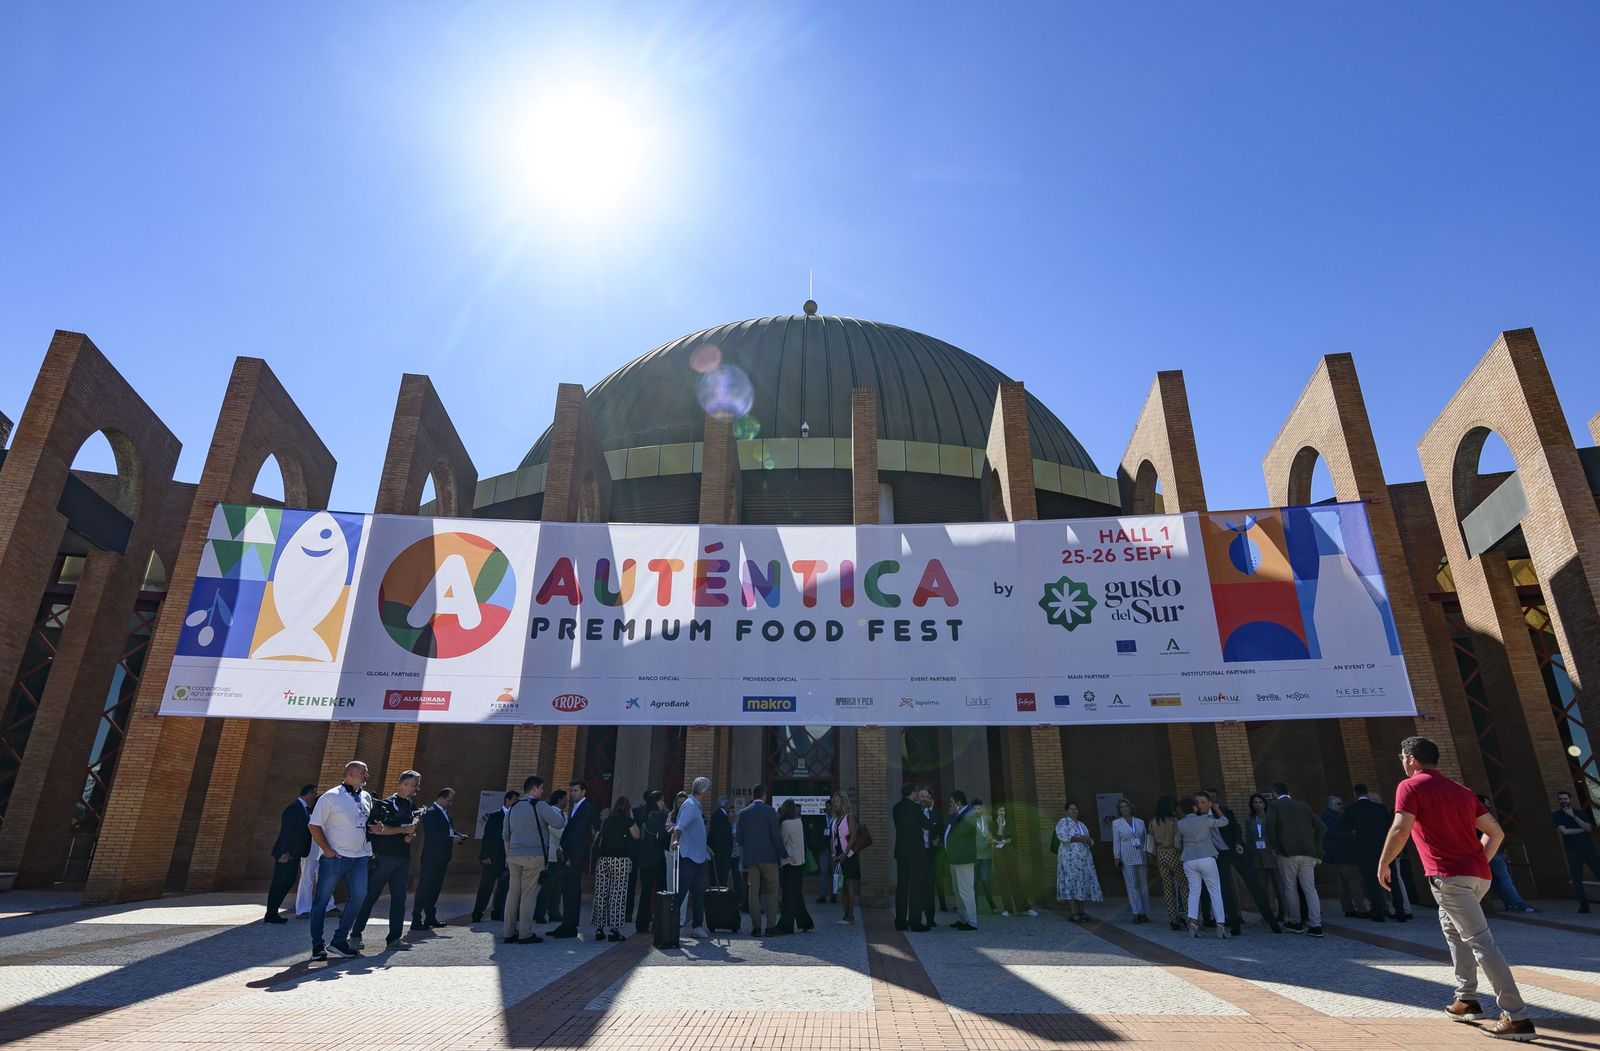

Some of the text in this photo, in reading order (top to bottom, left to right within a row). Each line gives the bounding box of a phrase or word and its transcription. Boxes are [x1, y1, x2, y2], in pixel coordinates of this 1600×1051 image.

[1099, 526, 1169, 544] HALL 1
[1061, 545, 1174, 564] 25-26 SEPT
[535, 541, 960, 608] AUTÉNTICA
[993, 581, 1014, 597] by
[1104, 574, 1182, 608] gusto
[1111, 599, 1185, 624] del Sur
[530, 617, 963, 642] PREMIUM FOOD FEST
[287, 695, 356, 707] HEINEKEN
[553, 695, 587, 709] TROPS
[649, 700, 690, 708] AgroBank
[747, 698, 792, 710] makro
